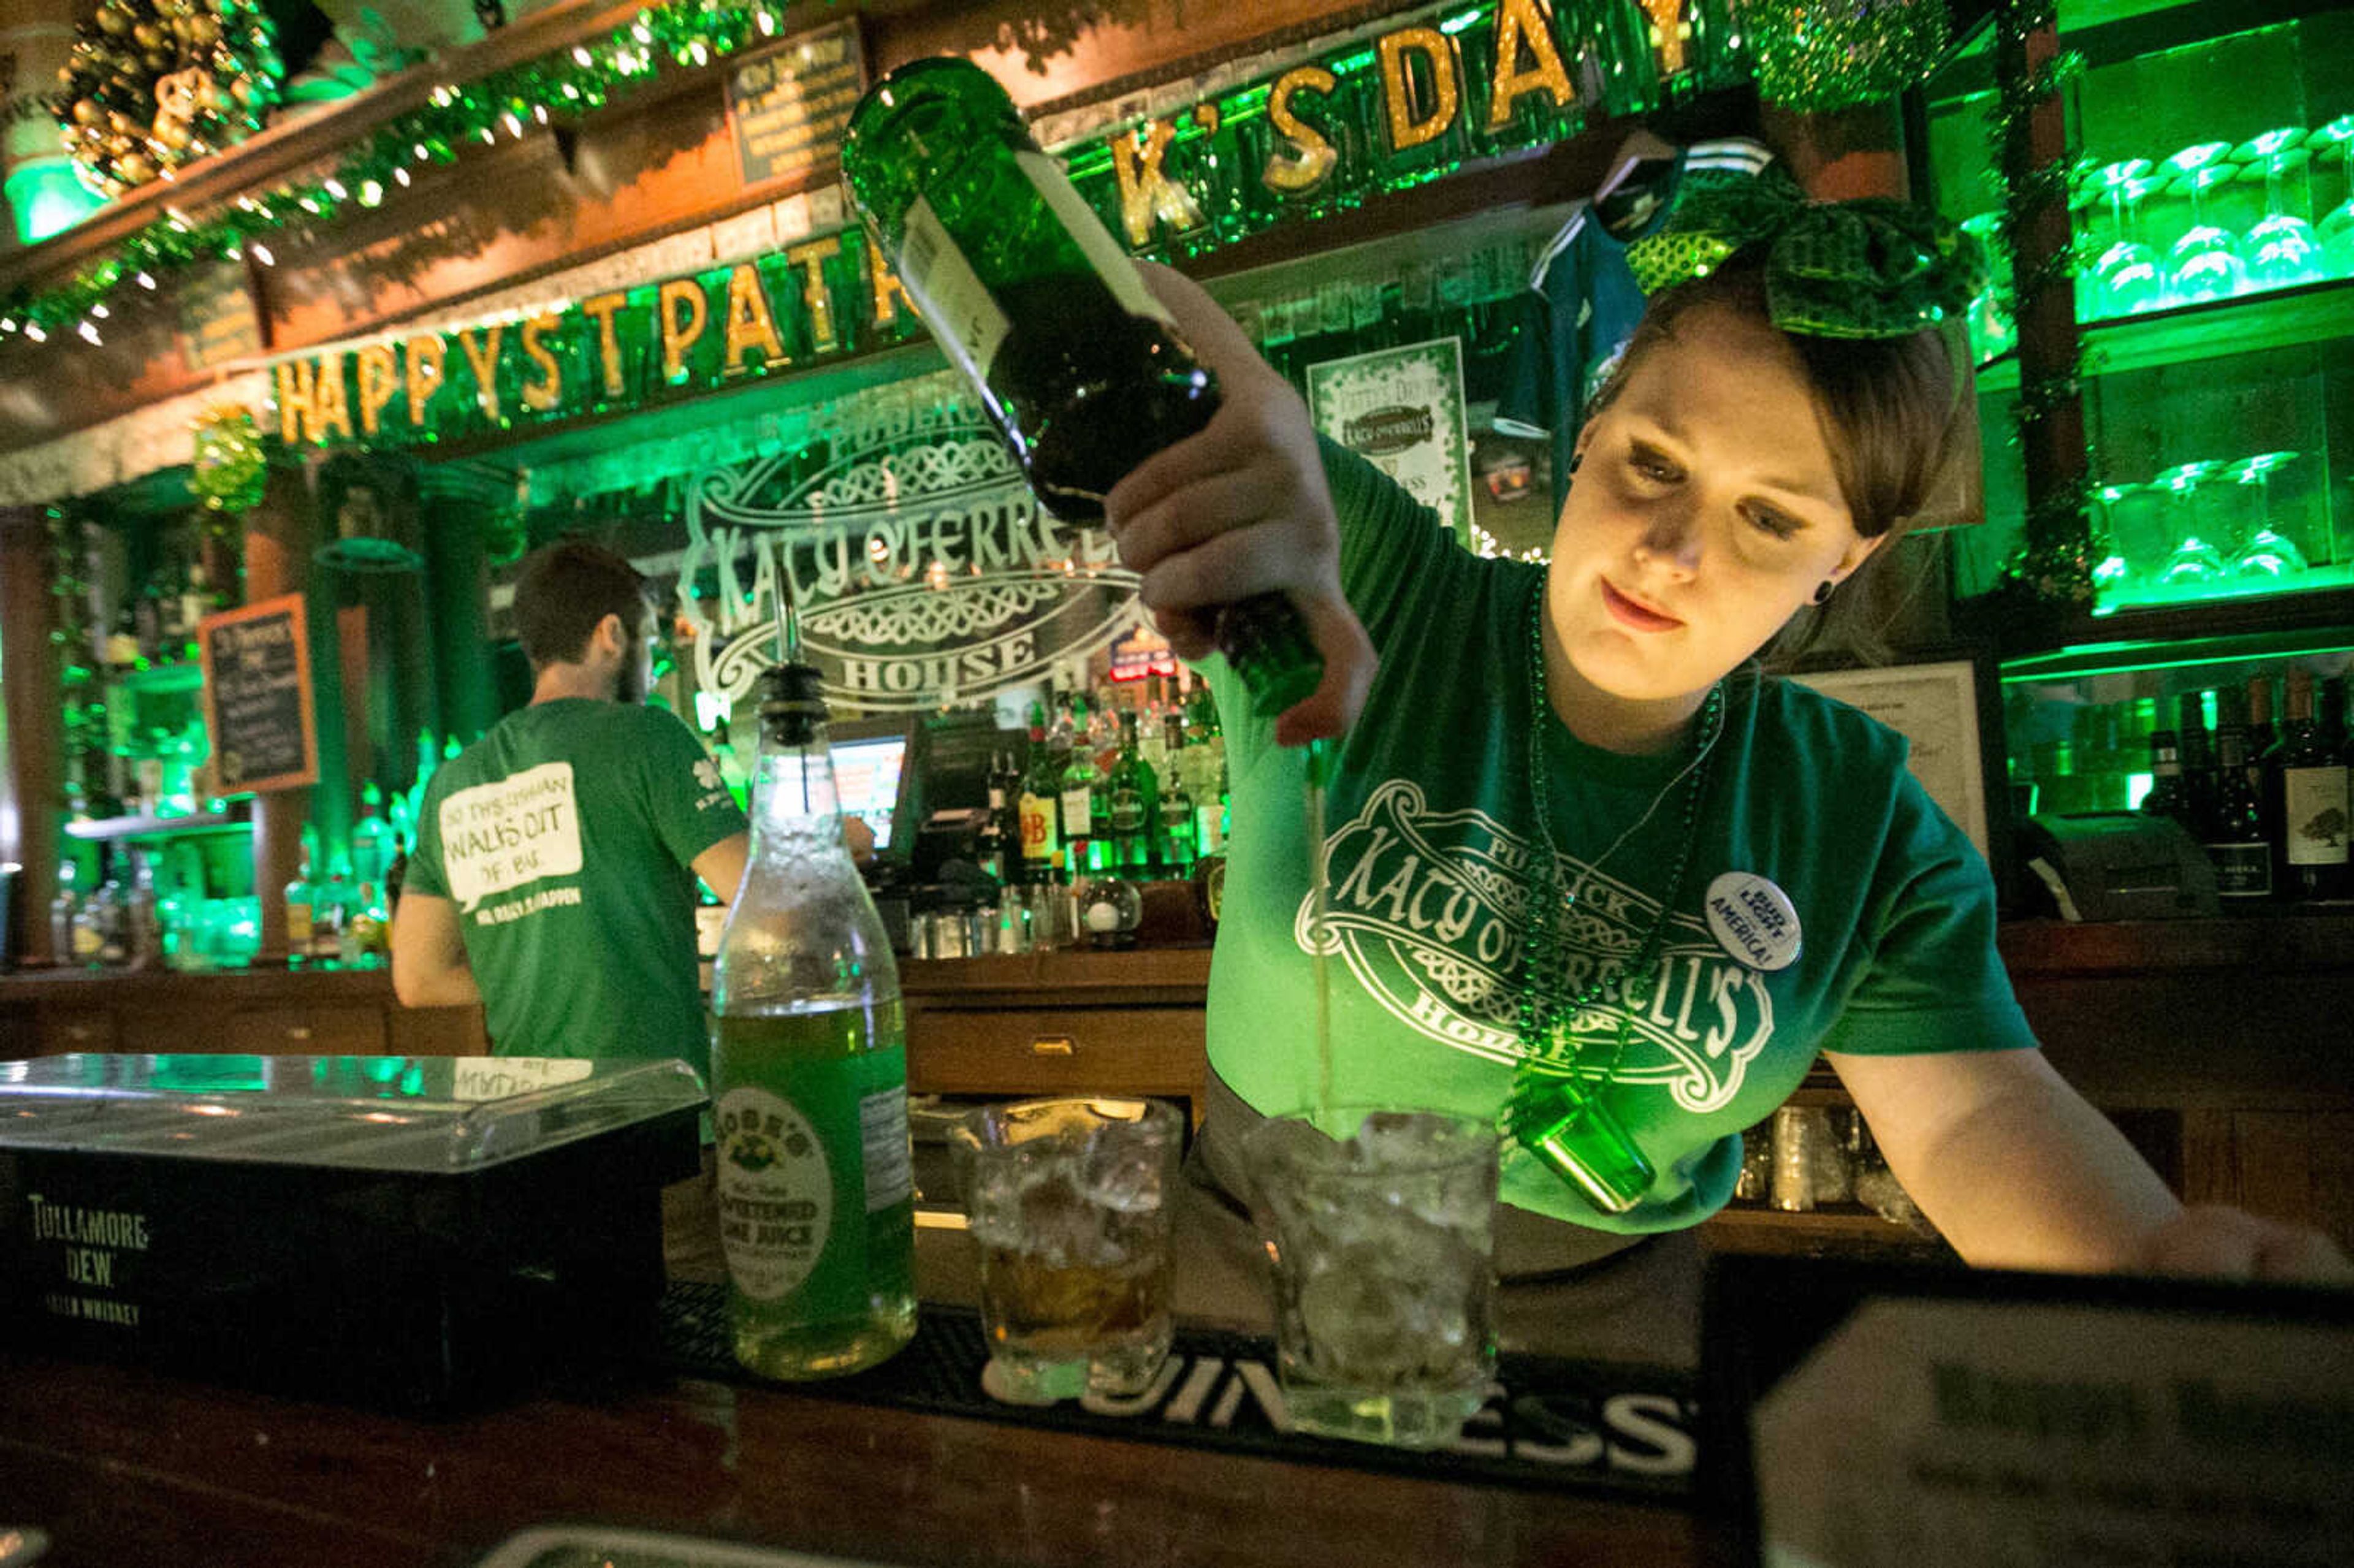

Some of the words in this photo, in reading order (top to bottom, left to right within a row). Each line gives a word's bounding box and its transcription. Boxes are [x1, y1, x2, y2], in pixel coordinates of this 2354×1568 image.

[276, 320, 501, 446] HAPPY
[1377, 0, 1693, 148] DAY
[844, 633, 1036, 691] HOUSE
[1710, 897, 1773, 967] AMERICA!
[1740, 889, 1783, 939] LIGHT
[1753, 889, 1786, 927] BUD
[28, 1193, 149, 1250] TULLAMORE
